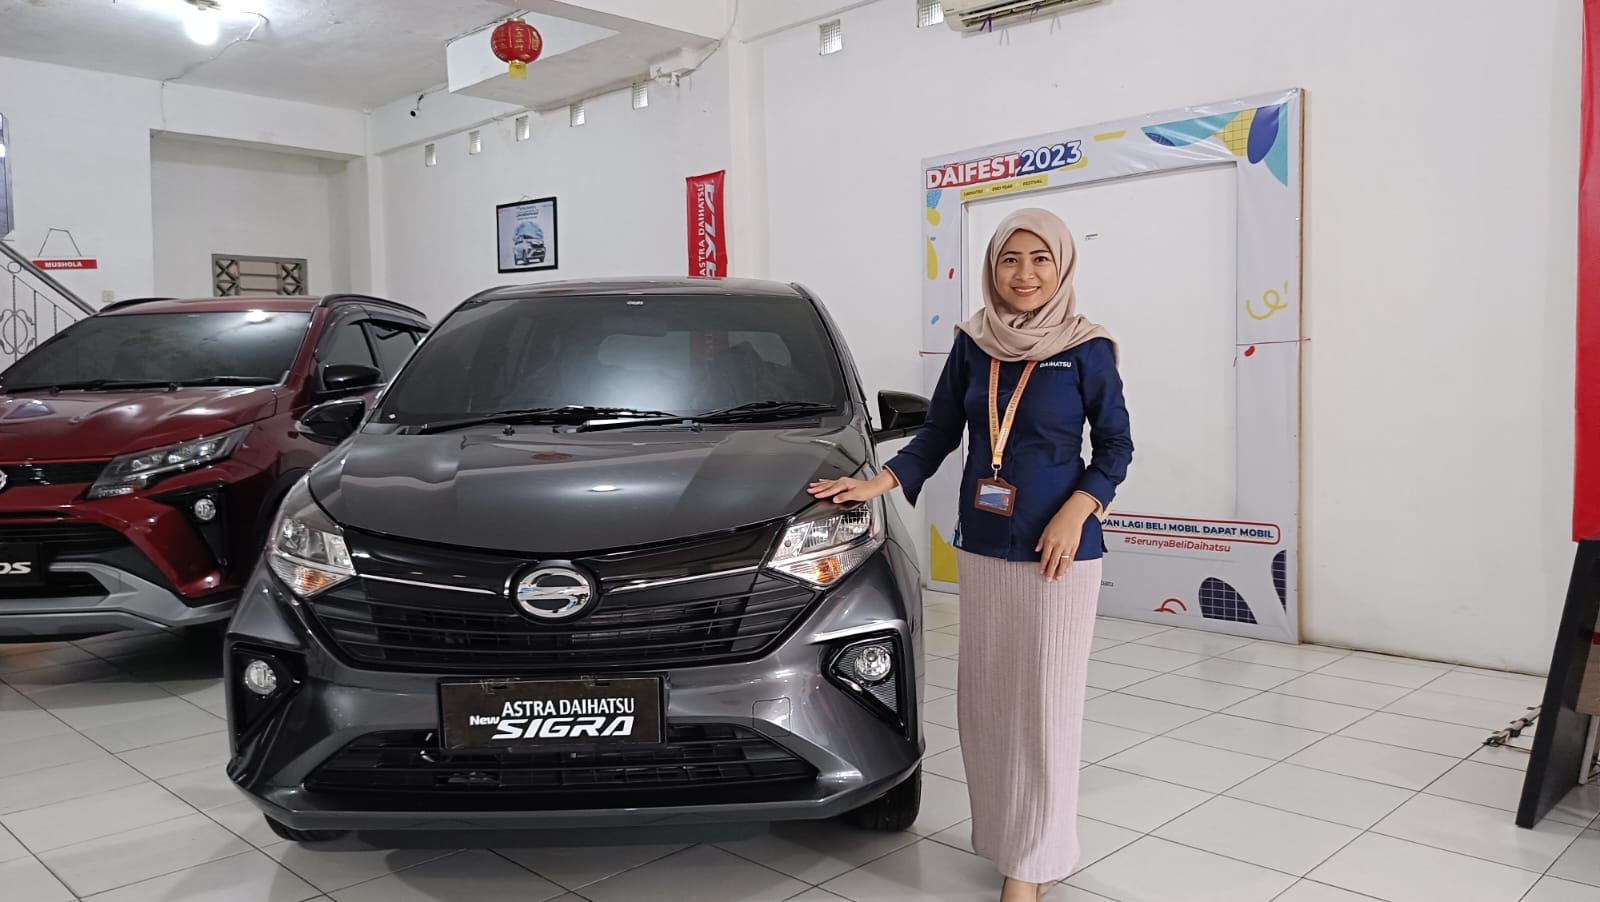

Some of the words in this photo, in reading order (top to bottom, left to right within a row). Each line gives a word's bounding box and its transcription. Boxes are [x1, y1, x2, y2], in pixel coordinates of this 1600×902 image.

[927, 154, 1020, 188] DAIFEST
[1021, 140, 1082, 172] 2023
[697, 183, 705, 236] DAIHATSU
[698, 239, 706, 276] ASTRA
[1122, 520, 1144, 529] LAGI
[1145, 521, 1167, 530] BELI
[1168, 523, 1201, 533] MOBIL
[1202, 525, 1237, 536] DAPAT
[1239, 527, 1274, 539] MOBIL
[1124, 536, 1231, 553] #SerunyaBeliDaihatsu
[502, 700, 556, 718] ASTRA
[559, 697, 635, 715] DAIHATSU
[469, 715, 500, 726] New
[491, 715, 635, 740] SIGRA
